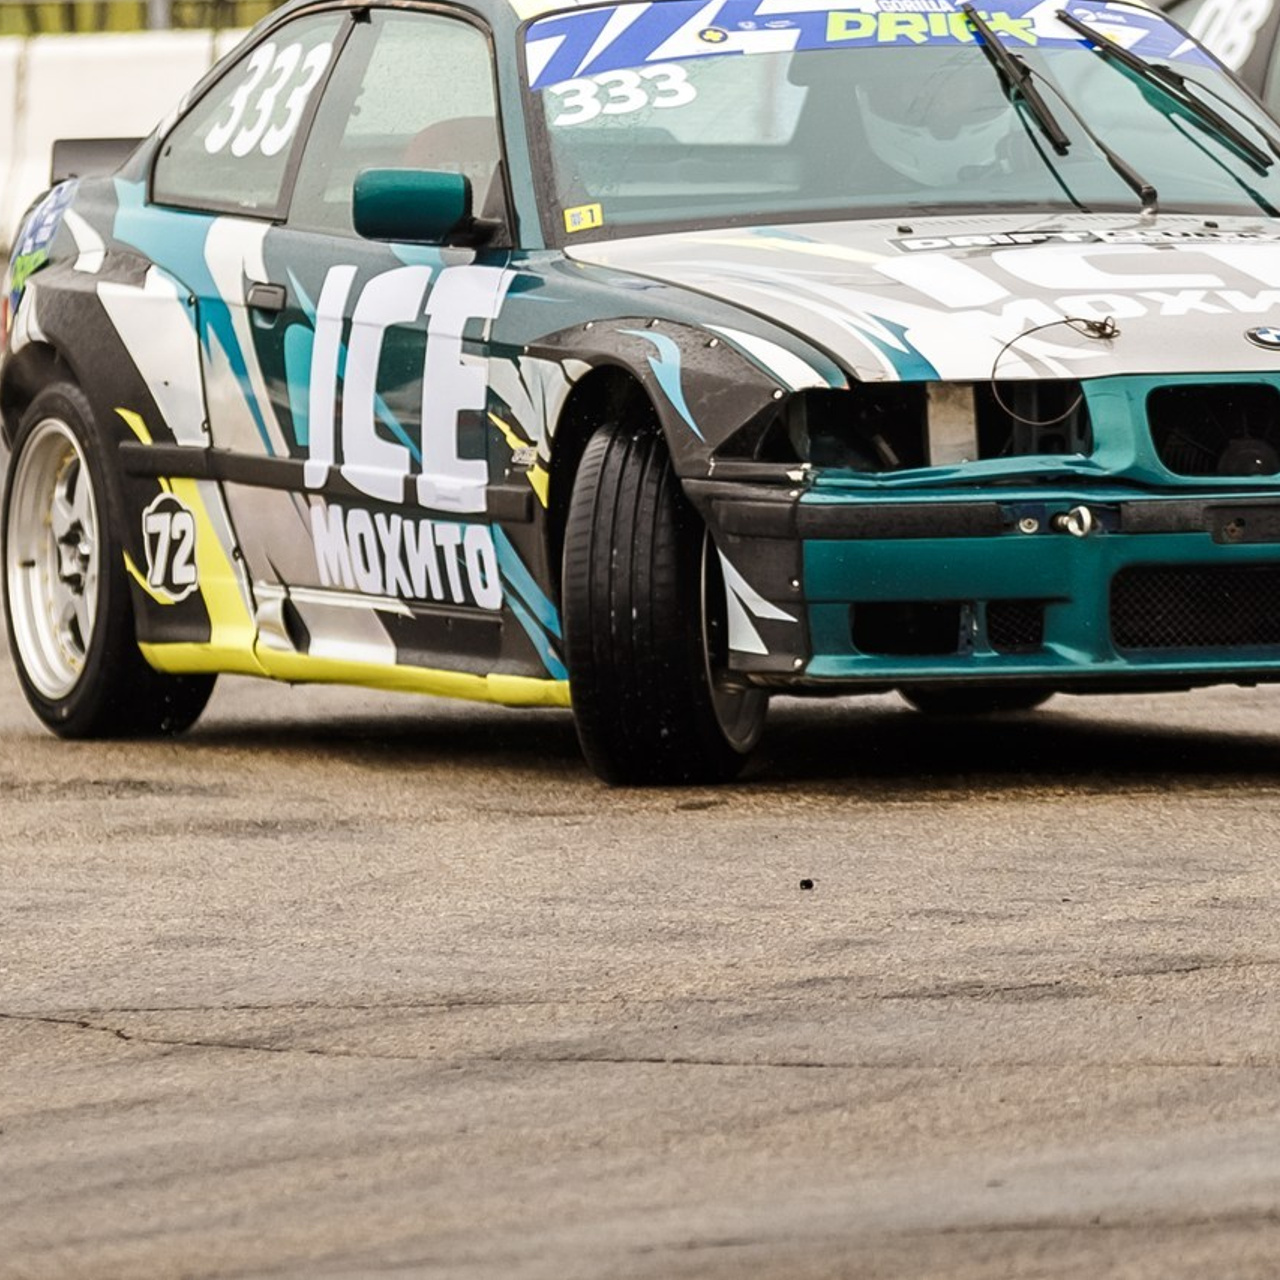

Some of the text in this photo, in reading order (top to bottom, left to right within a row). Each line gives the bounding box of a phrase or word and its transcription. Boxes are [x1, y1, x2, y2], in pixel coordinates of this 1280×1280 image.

[205, 41, 333, 157] 333
[549, 63, 698, 126] 333
[899, 231, 1091, 251] DRIFT
[304, 264, 517, 513] ICE
[145, 510, 196, 587] 72
[310, 503, 501, 610] МОХИТО
